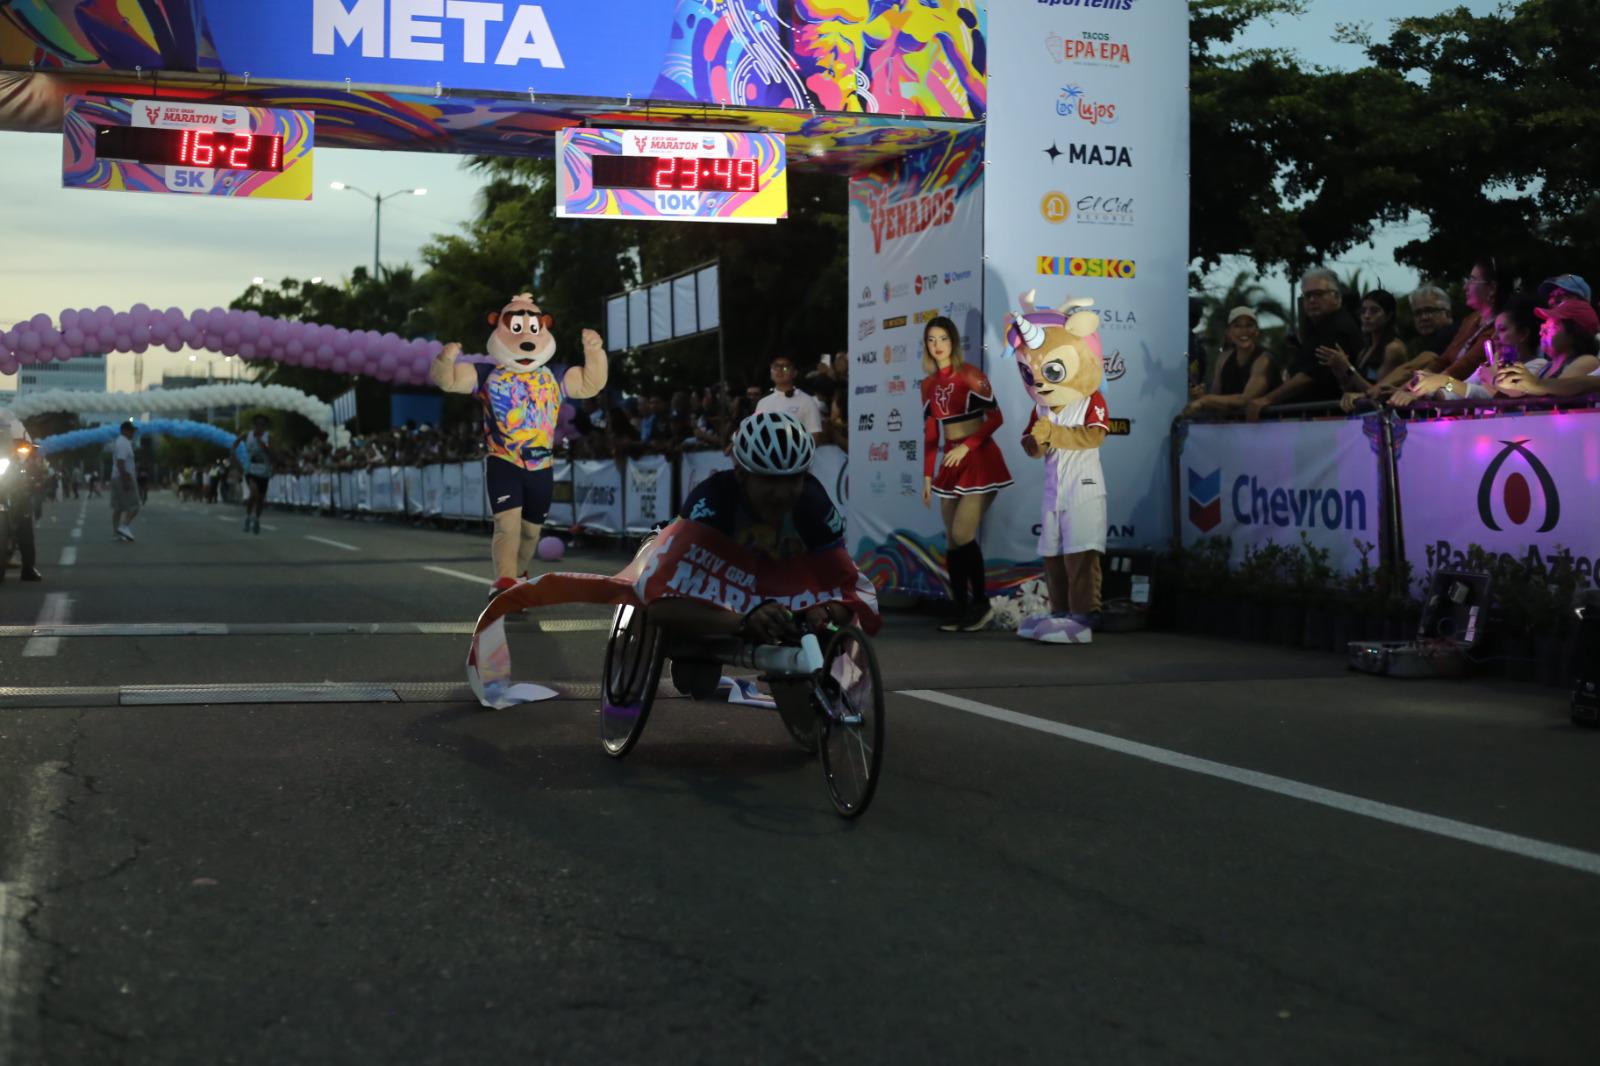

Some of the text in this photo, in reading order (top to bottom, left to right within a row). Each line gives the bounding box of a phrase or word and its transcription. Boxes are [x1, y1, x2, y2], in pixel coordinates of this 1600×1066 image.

[312, 0, 566, 69] META
[1082, 31, 1110, 41] TACOS
[1064, 39, 1131, 64] EPA EPA
[1078, 97, 1116, 125] Lujos
[1069, 143, 1133, 168] MAJA
[174, 169, 205, 188] 5K
[657, 193, 697, 211] 10K
[1077, 195, 1102, 211] El
[1036, 255, 1136, 279] KIOSKO
[923, 274, 939, 292] TVP
[1231, 473, 1367, 531] Chevron
[683, 543, 727, 574] XXIV
